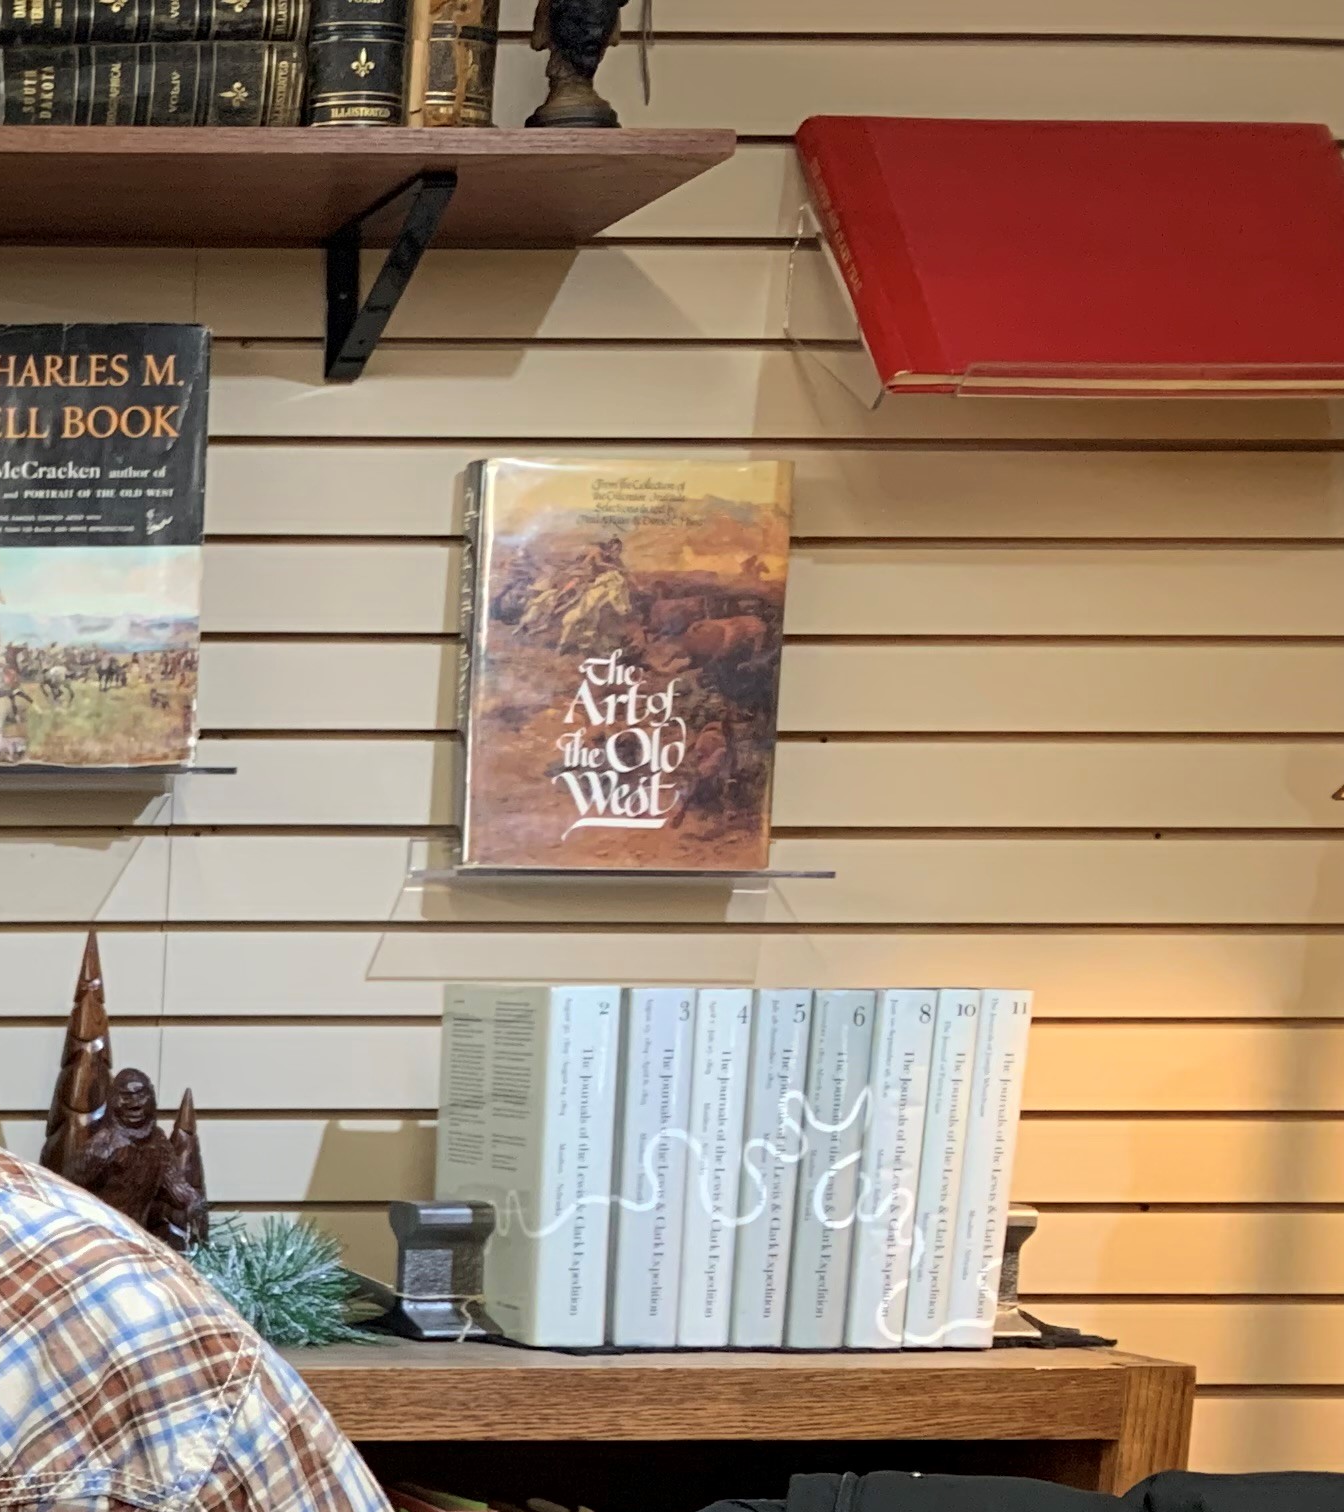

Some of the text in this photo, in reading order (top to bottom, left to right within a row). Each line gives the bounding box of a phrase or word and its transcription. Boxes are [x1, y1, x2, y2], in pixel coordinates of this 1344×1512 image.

[22, 69, 37, 113] SOUTH
[39, 65, 55, 120] DAKOTA
[330, 107, 390, 118] ILLUSTRATED
[142, 354, 185, 388] M.
[62, 405, 181, 439] BOOK
[579, 648, 645, 687] The
[564, 678, 682, 725] Art of
[555, 716, 687, 775] the Old
[551, 770, 682, 818] West
[679, 1001, 691, 1021] 3
[737, 1004, 749, 1024] 4
[793, 1003, 805, 1024] 5
[853, 1006, 866, 1027] 6
[919, 1003, 932, 1024] 8
[957, 1003, 976, 1018] 10
[1012, 1002, 1027, 1015] 11
[662, 1048, 674, 1069] The
[781, 1049, 794, 1070] The
[835, 1052, 848, 1073] The
[902, 1052, 915, 1072] The
[1002, 1053, 1016, 1073] The
[658, 1075, 673, 1124] Journals
[996, 1079, 1013, 1128] Journals
[829, 1131, 842, 1142] of
[896, 1131, 908, 1142] of
[994, 1132, 1007, 1143] of
[657, 1144, 669, 1162] the
[827, 1147, 840, 1166] the
[894, 1147, 907, 1165] the
[992, 1148, 1005, 1166] the
[568, 1048, 594, 1316] The Journals of the Lewis & Clark Expedition
[704, 1051, 732, 1318] The Journals of the Lewis & Clark Expedition
[771, 1167, 785, 1200] Lewis
[927, 1052, 967, 1319] The Journals of the Lewis & Clark Expedition
[988, 1170, 1003, 1202] Lewis
[654, 1202, 666, 1212] &
[770, 1204, 782, 1213] &
[823, 1206, 836, 1215] &
[890, 1205, 902, 1214] &
[987, 1206, 999, 1215] &
[652, 1217, 666, 1249] Clark
[767, 1218, 781, 1250] Clark
[983, 1220, 998, 1252] Clark
[648, 1252, 664, 1316] Expedition
[762, 1254, 779, 1318] Expedition
[815, 1255, 832, 1319] Expedition
